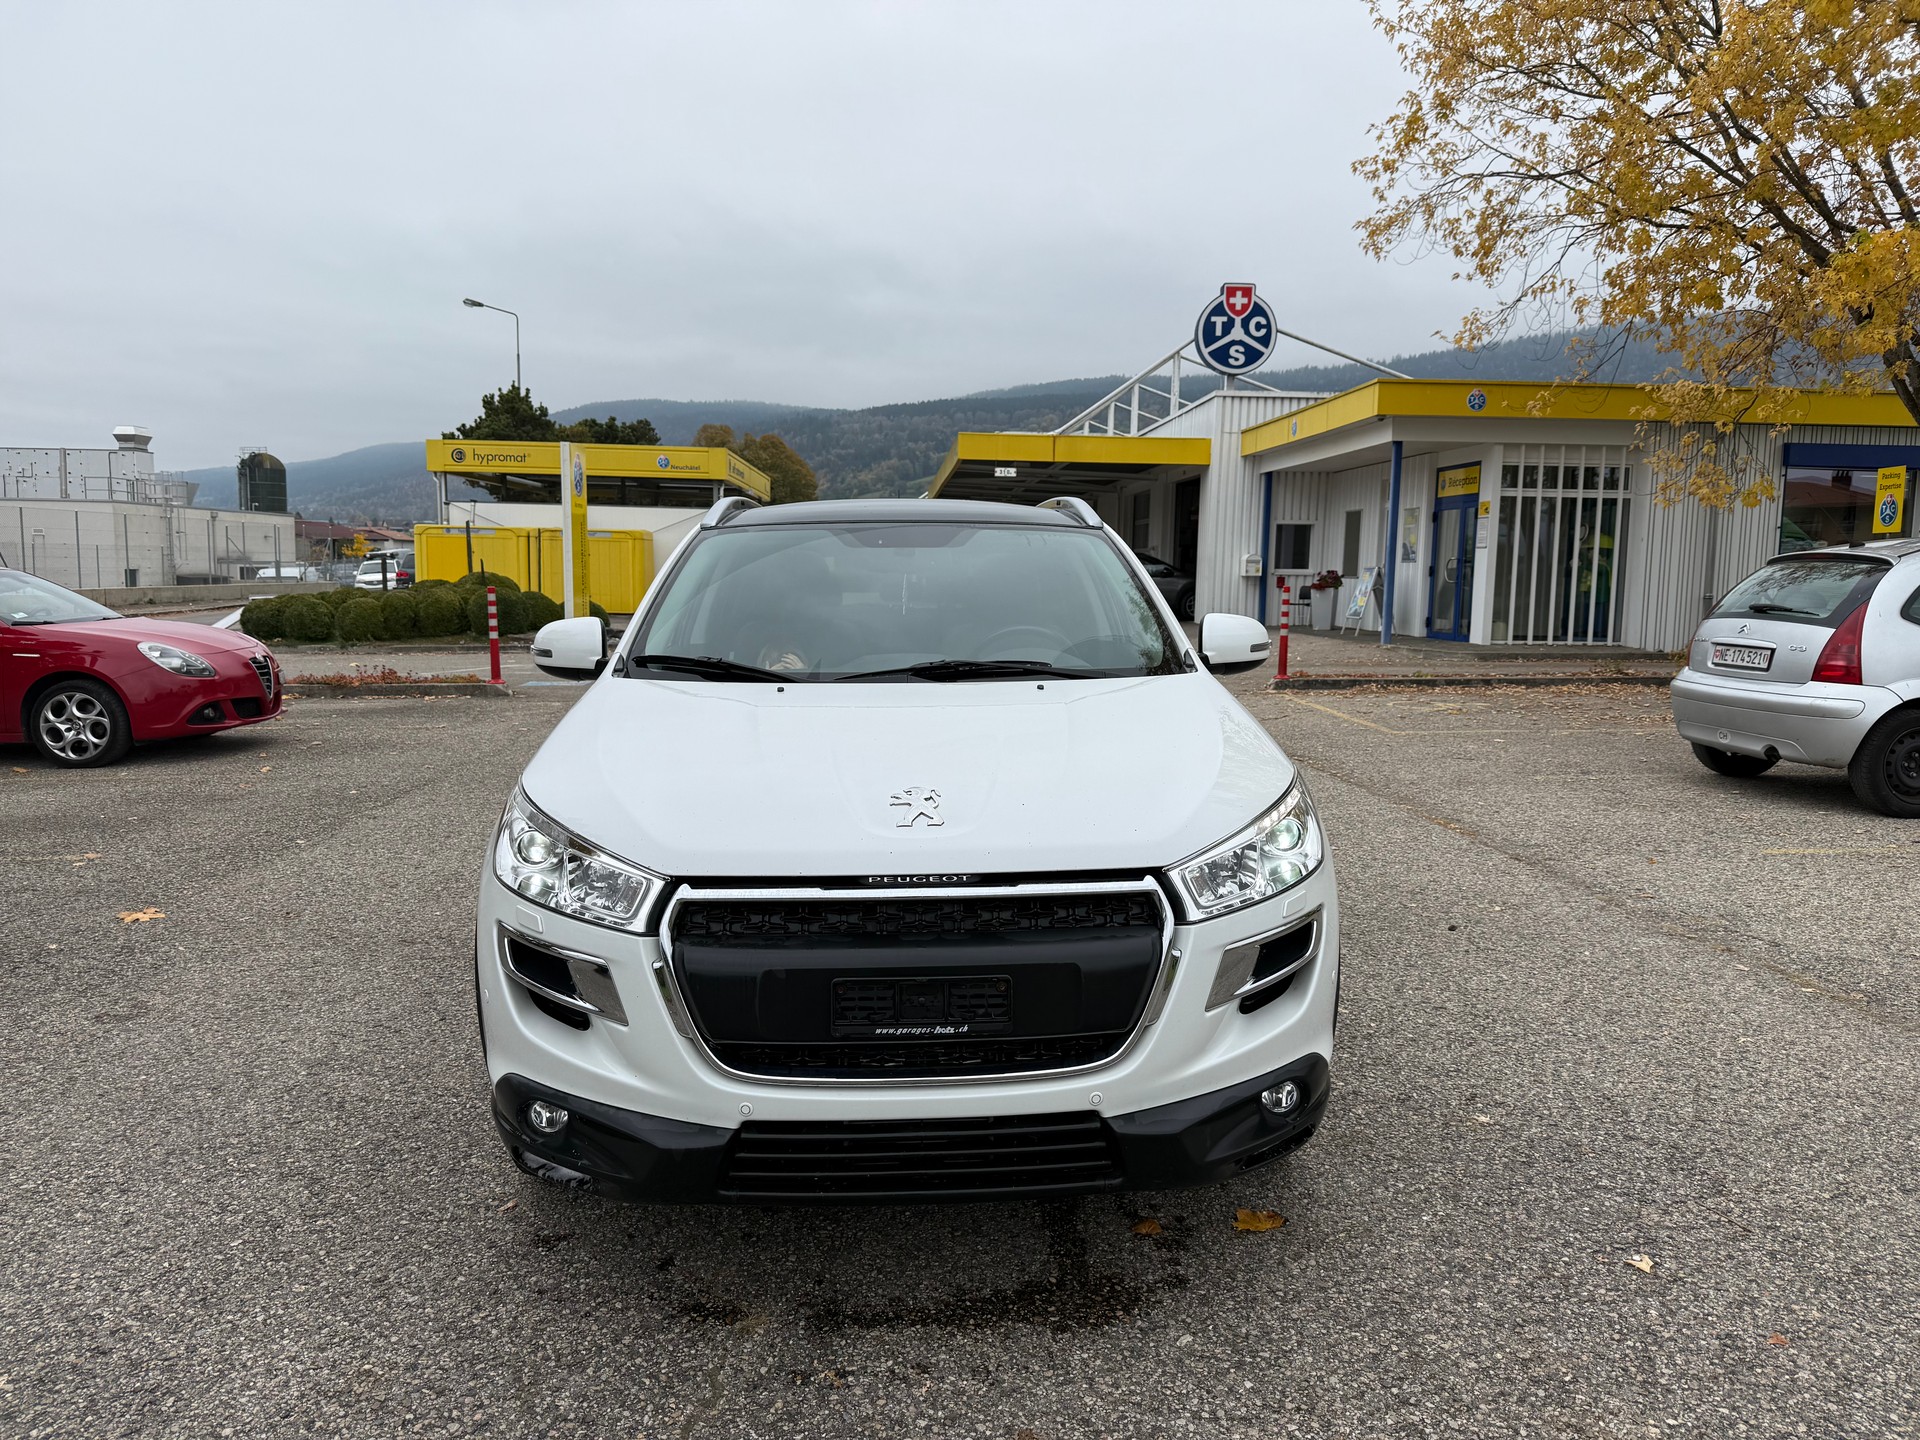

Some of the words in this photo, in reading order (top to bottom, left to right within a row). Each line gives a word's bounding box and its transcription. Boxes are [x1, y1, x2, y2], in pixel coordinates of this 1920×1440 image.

[472, 448, 527, 464] hypromat
[1448, 476, 1478, 488] Réception
[1879, 483, 1902, 491] Expertise
[868, 874, 972, 883] PEUGEOT
[875, 1024, 969, 1035] www.garages-hotz.ch
